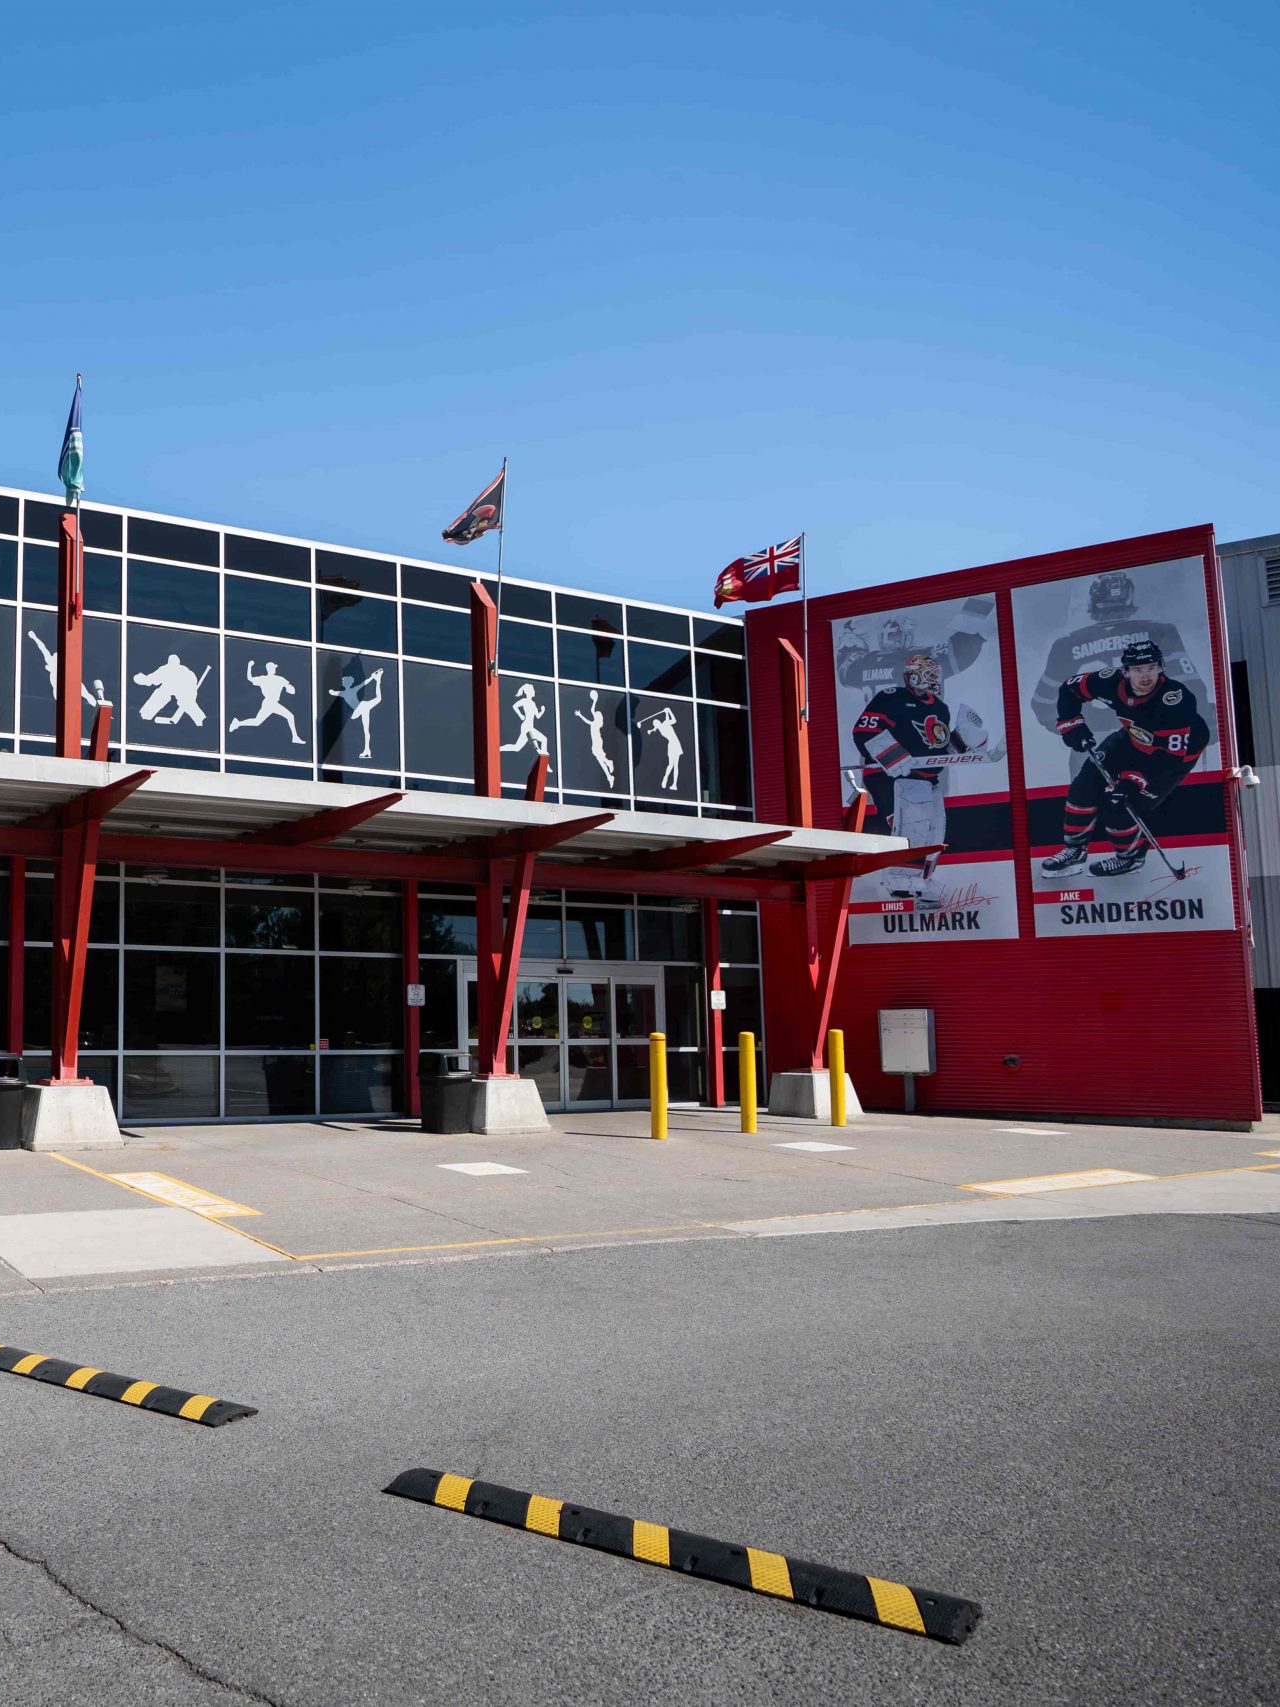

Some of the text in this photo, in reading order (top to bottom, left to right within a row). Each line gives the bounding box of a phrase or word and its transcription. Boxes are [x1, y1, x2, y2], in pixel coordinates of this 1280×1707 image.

[1072, 632, 1150, 660] SANDERSON
[858, 716, 880, 728] 35
[1060, 891, 1081, 902] JAKE
[881, 902, 904, 911] LINUS
[1060, 898, 1204, 925] SANDERSON
[883, 910, 981, 933] ULLMARK
